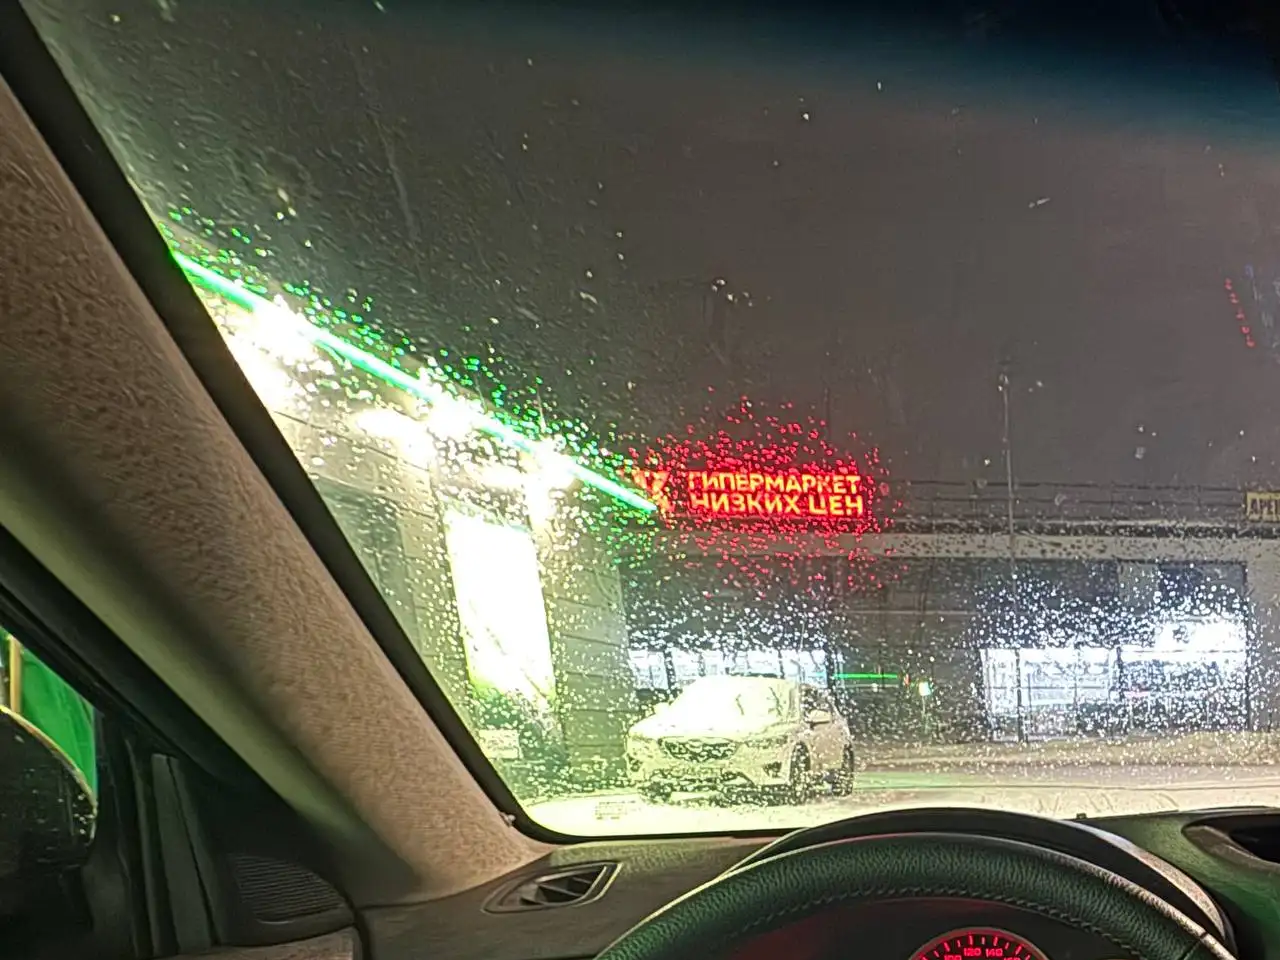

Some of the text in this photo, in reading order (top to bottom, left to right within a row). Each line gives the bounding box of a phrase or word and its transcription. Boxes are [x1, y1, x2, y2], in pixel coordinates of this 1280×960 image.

[689, 471, 861, 494] ГИПЕРМАРКЕТ
[689, 493, 863, 516] НИЗКИХ ЦЕН
[964, 948, 982, 957] 120
[985, 948, 1003, 957] 140
